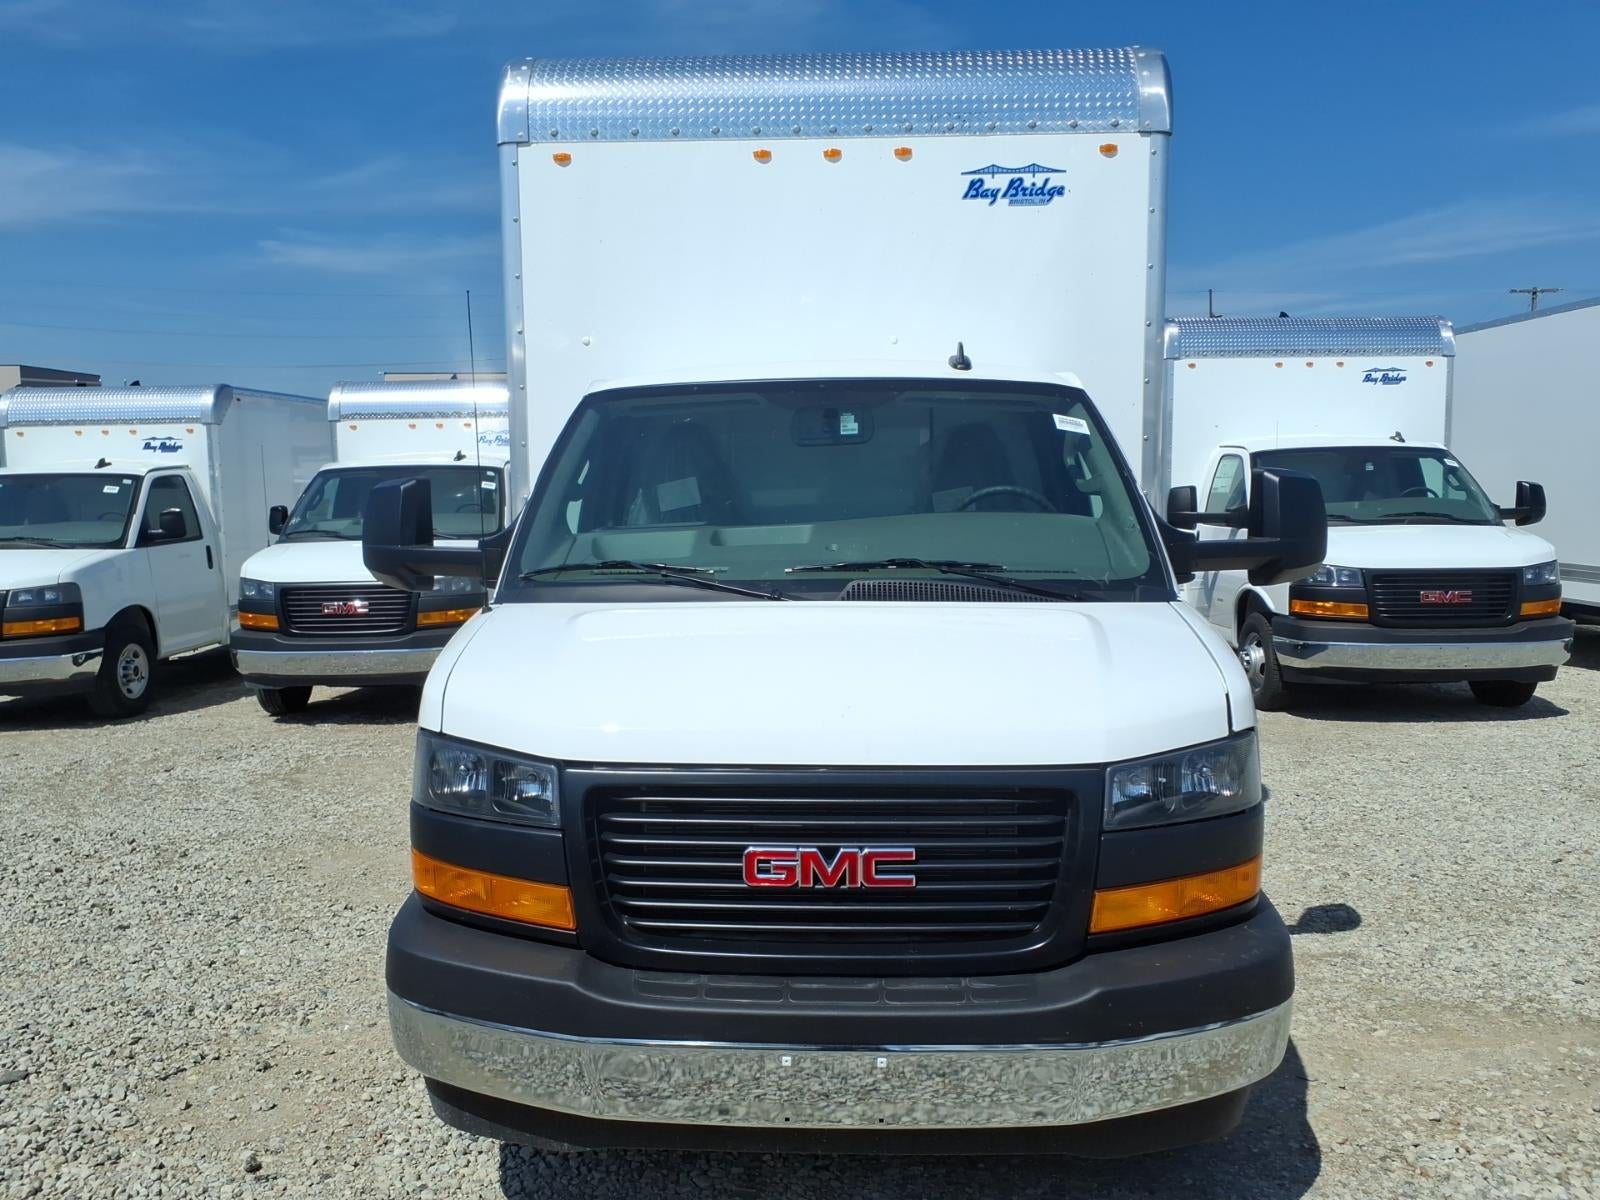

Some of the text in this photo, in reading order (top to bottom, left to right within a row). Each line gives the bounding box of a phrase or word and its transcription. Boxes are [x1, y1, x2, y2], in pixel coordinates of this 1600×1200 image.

[962, 177, 1065, 206] Bay Bridge
[1362, 373, 1379, 385] Bay
[1379, 372, 1407, 384] Bridge
[1420, 590, 1472, 603] GMC
[321, 601, 369, 615] GMC
[743, 847, 916, 888] GMC
